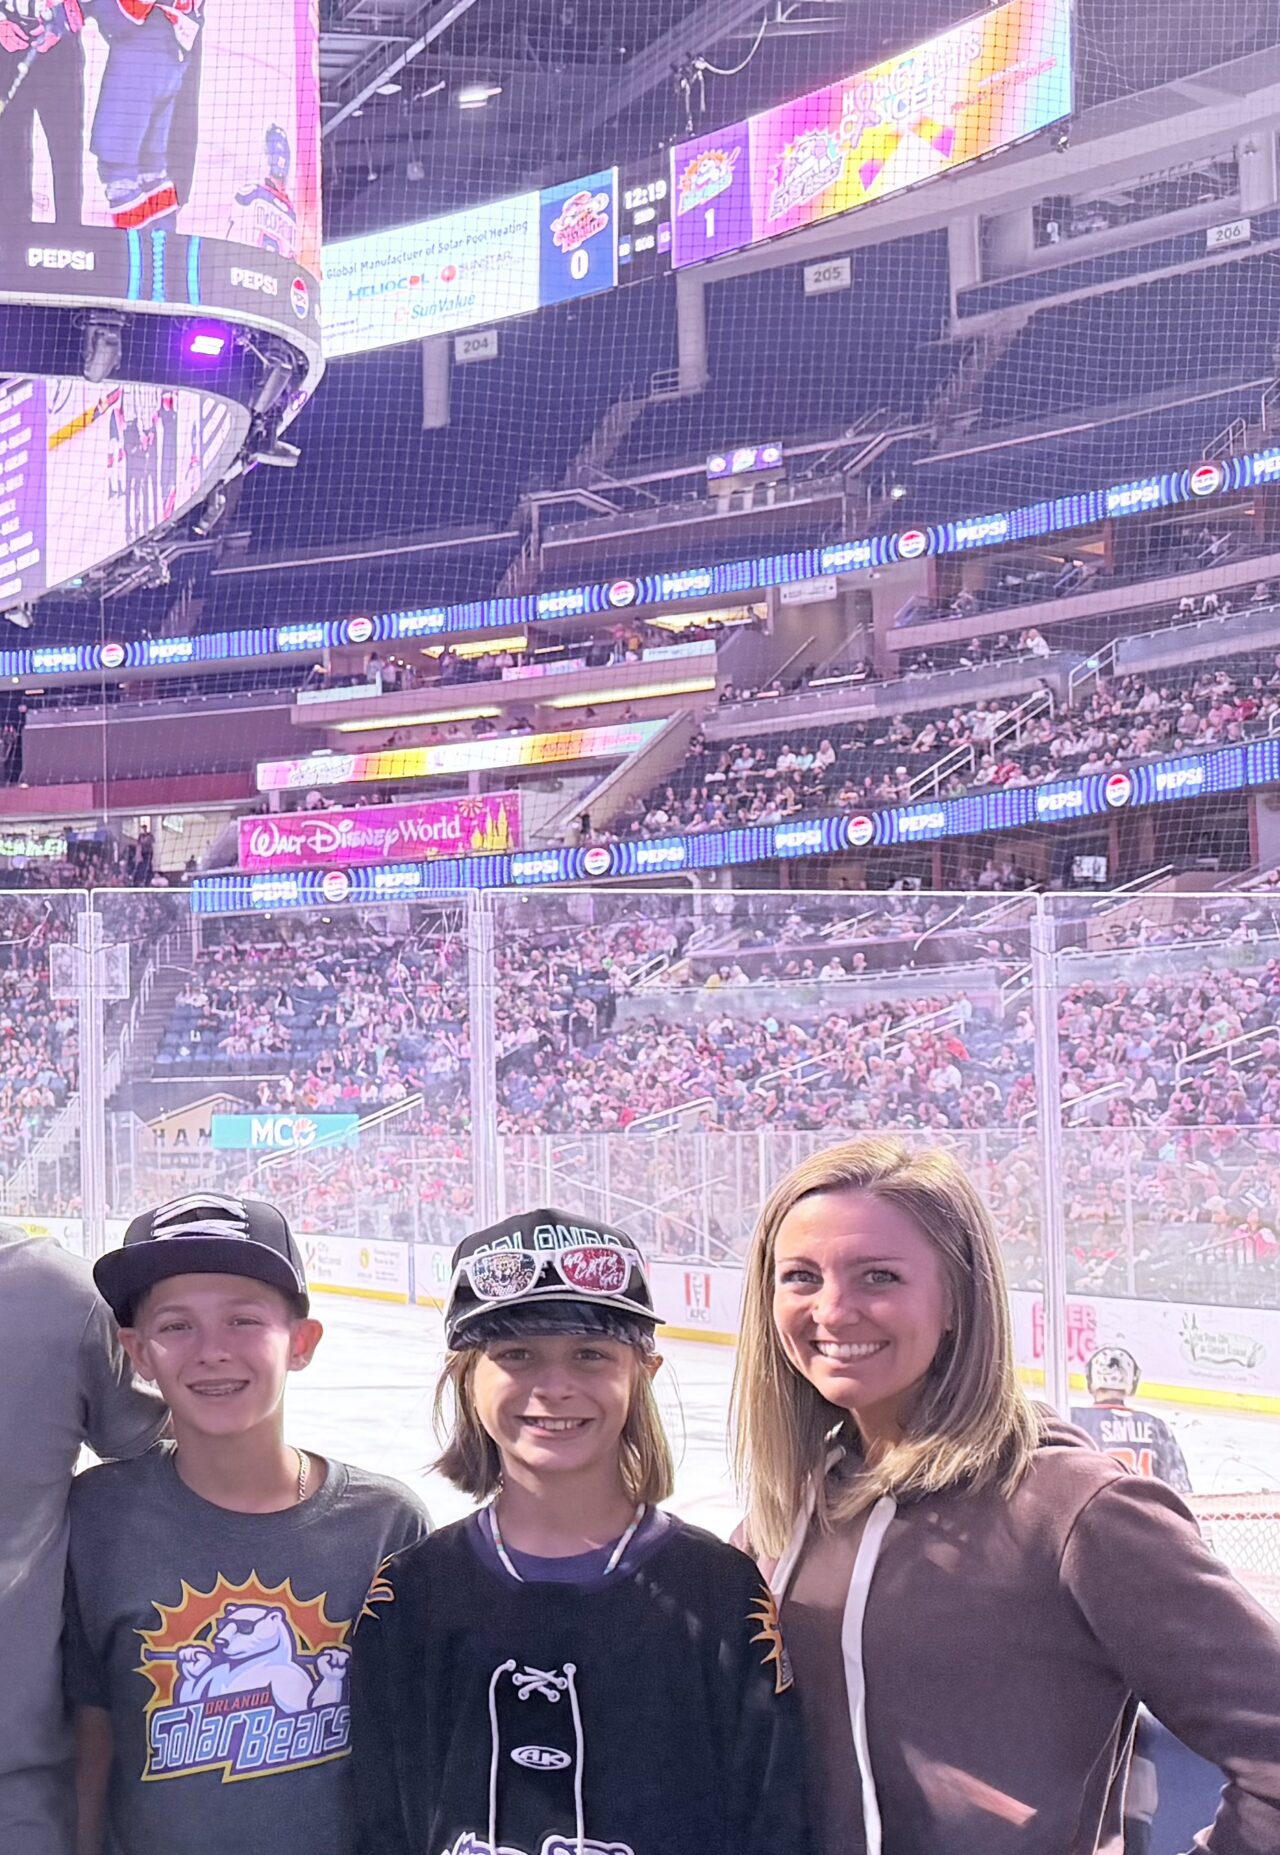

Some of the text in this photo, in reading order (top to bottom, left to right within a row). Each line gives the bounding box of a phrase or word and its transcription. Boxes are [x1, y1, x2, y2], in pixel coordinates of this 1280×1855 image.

[623, 180, 667, 209] 12:19
[704, 208, 716, 239] 1
[1214, 224, 1242, 242] 206
[27, 247, 95, 271] PEPSI
[570, 249, 589, 279] 0
[230, 266, 278, 297] PEPSI
[813, 265, 842, 282] 205
[463, 337, 489, 353] 204
[1107, 485, 1160, 510] PEPSI
[956, 520, 1007, 542] PEPSI
[823, 546, 871, 569] PEPSI
[663, 574, 711, 594] PEPSI
[538, 594, 584, 614] PEPSI
[398, 613, 444, 632] PEPSI
[278, 628, 323, 646] PEPSI
[149, 642, 193, 659] PEPSI
[1156, 767, 1204, 791] PEPSI
[1036, 790, 1083, 812] PEPSI
[399, 815, 462, 843] World
[898, 813, 945, 833] PEPSI
[775, 830, 822, 849] PEPSI
[637, 847, 685, 866] PEPSI
[512, 859, 559, 877] PEPSI
[375, 872, 420, 888] PEPSI
[690, 1308, 708, 1321] KFC
[1032, 1302, 1098, 1332] BER
[204, 1692, 270, 1716] ORLANDO
